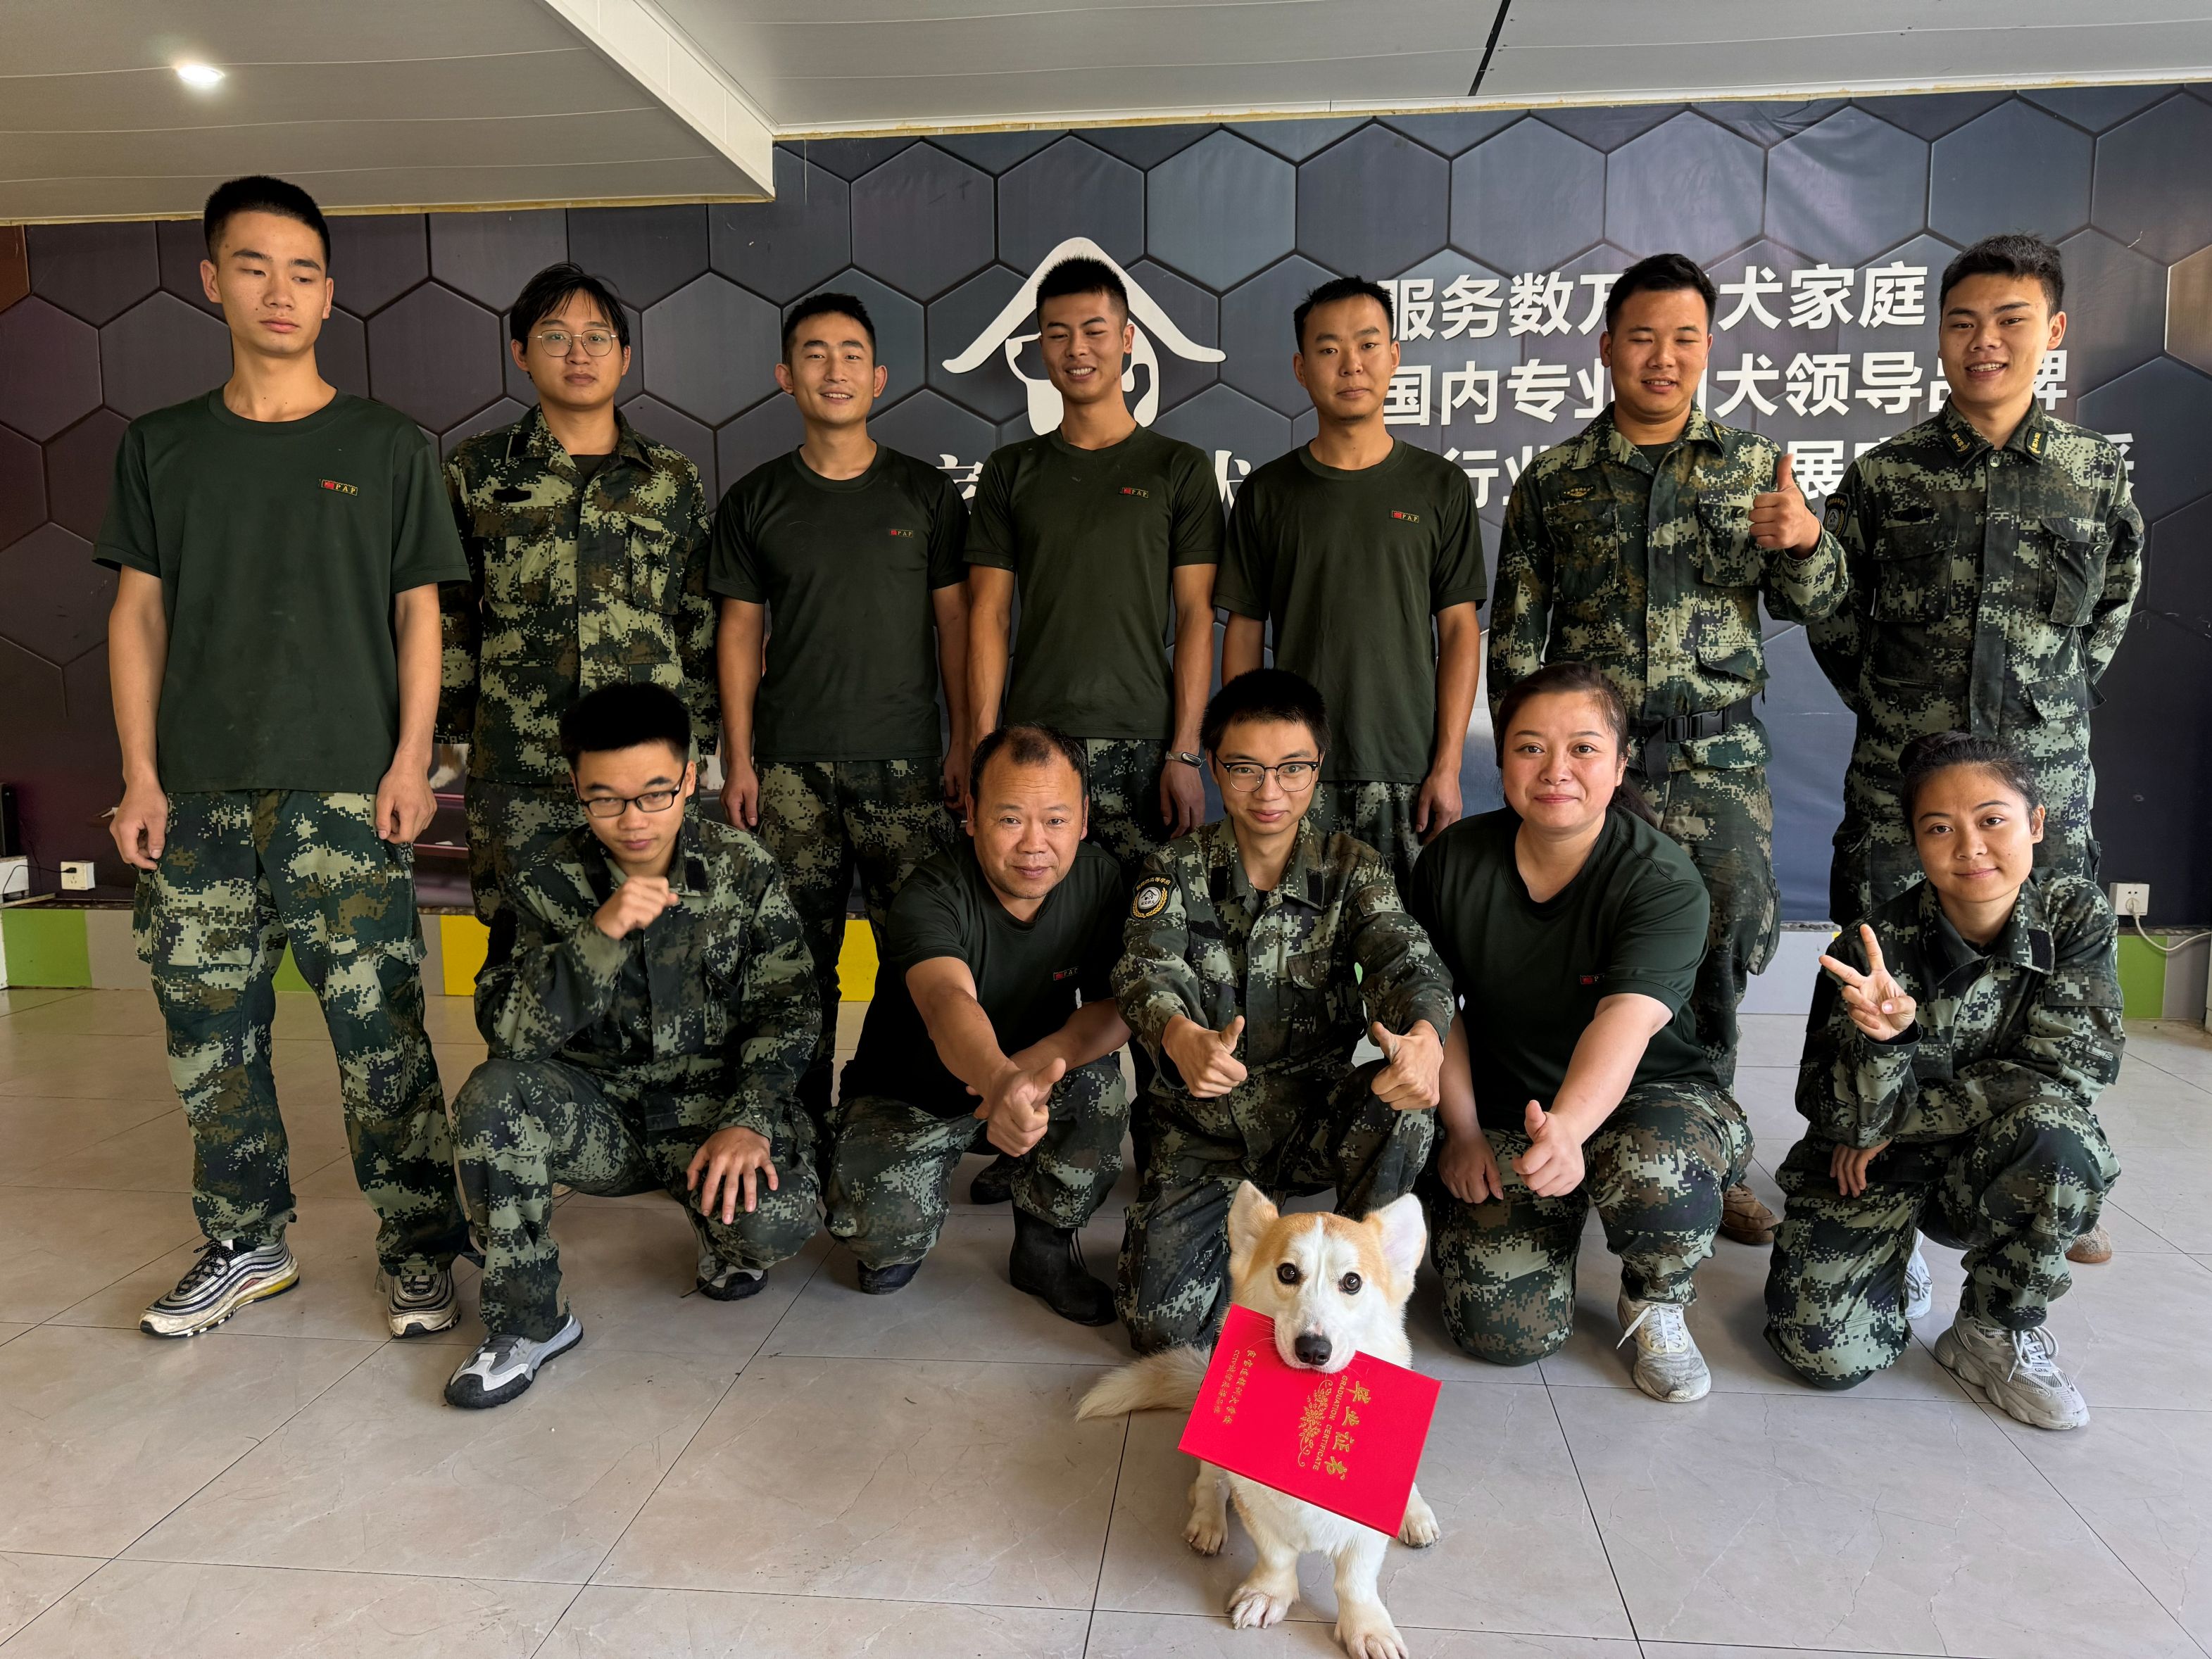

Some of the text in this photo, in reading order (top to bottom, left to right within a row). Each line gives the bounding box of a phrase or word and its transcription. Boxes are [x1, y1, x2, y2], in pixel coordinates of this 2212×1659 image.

[1377, 261, 1928, 341] 服务数万犬家庭
[335, 484, 356, 493] PAP
[1312, 1375, 1348, 1471] GRADUATION CERTIFICATE
[1324, 1380, 1371, 1480] 毕业证书
